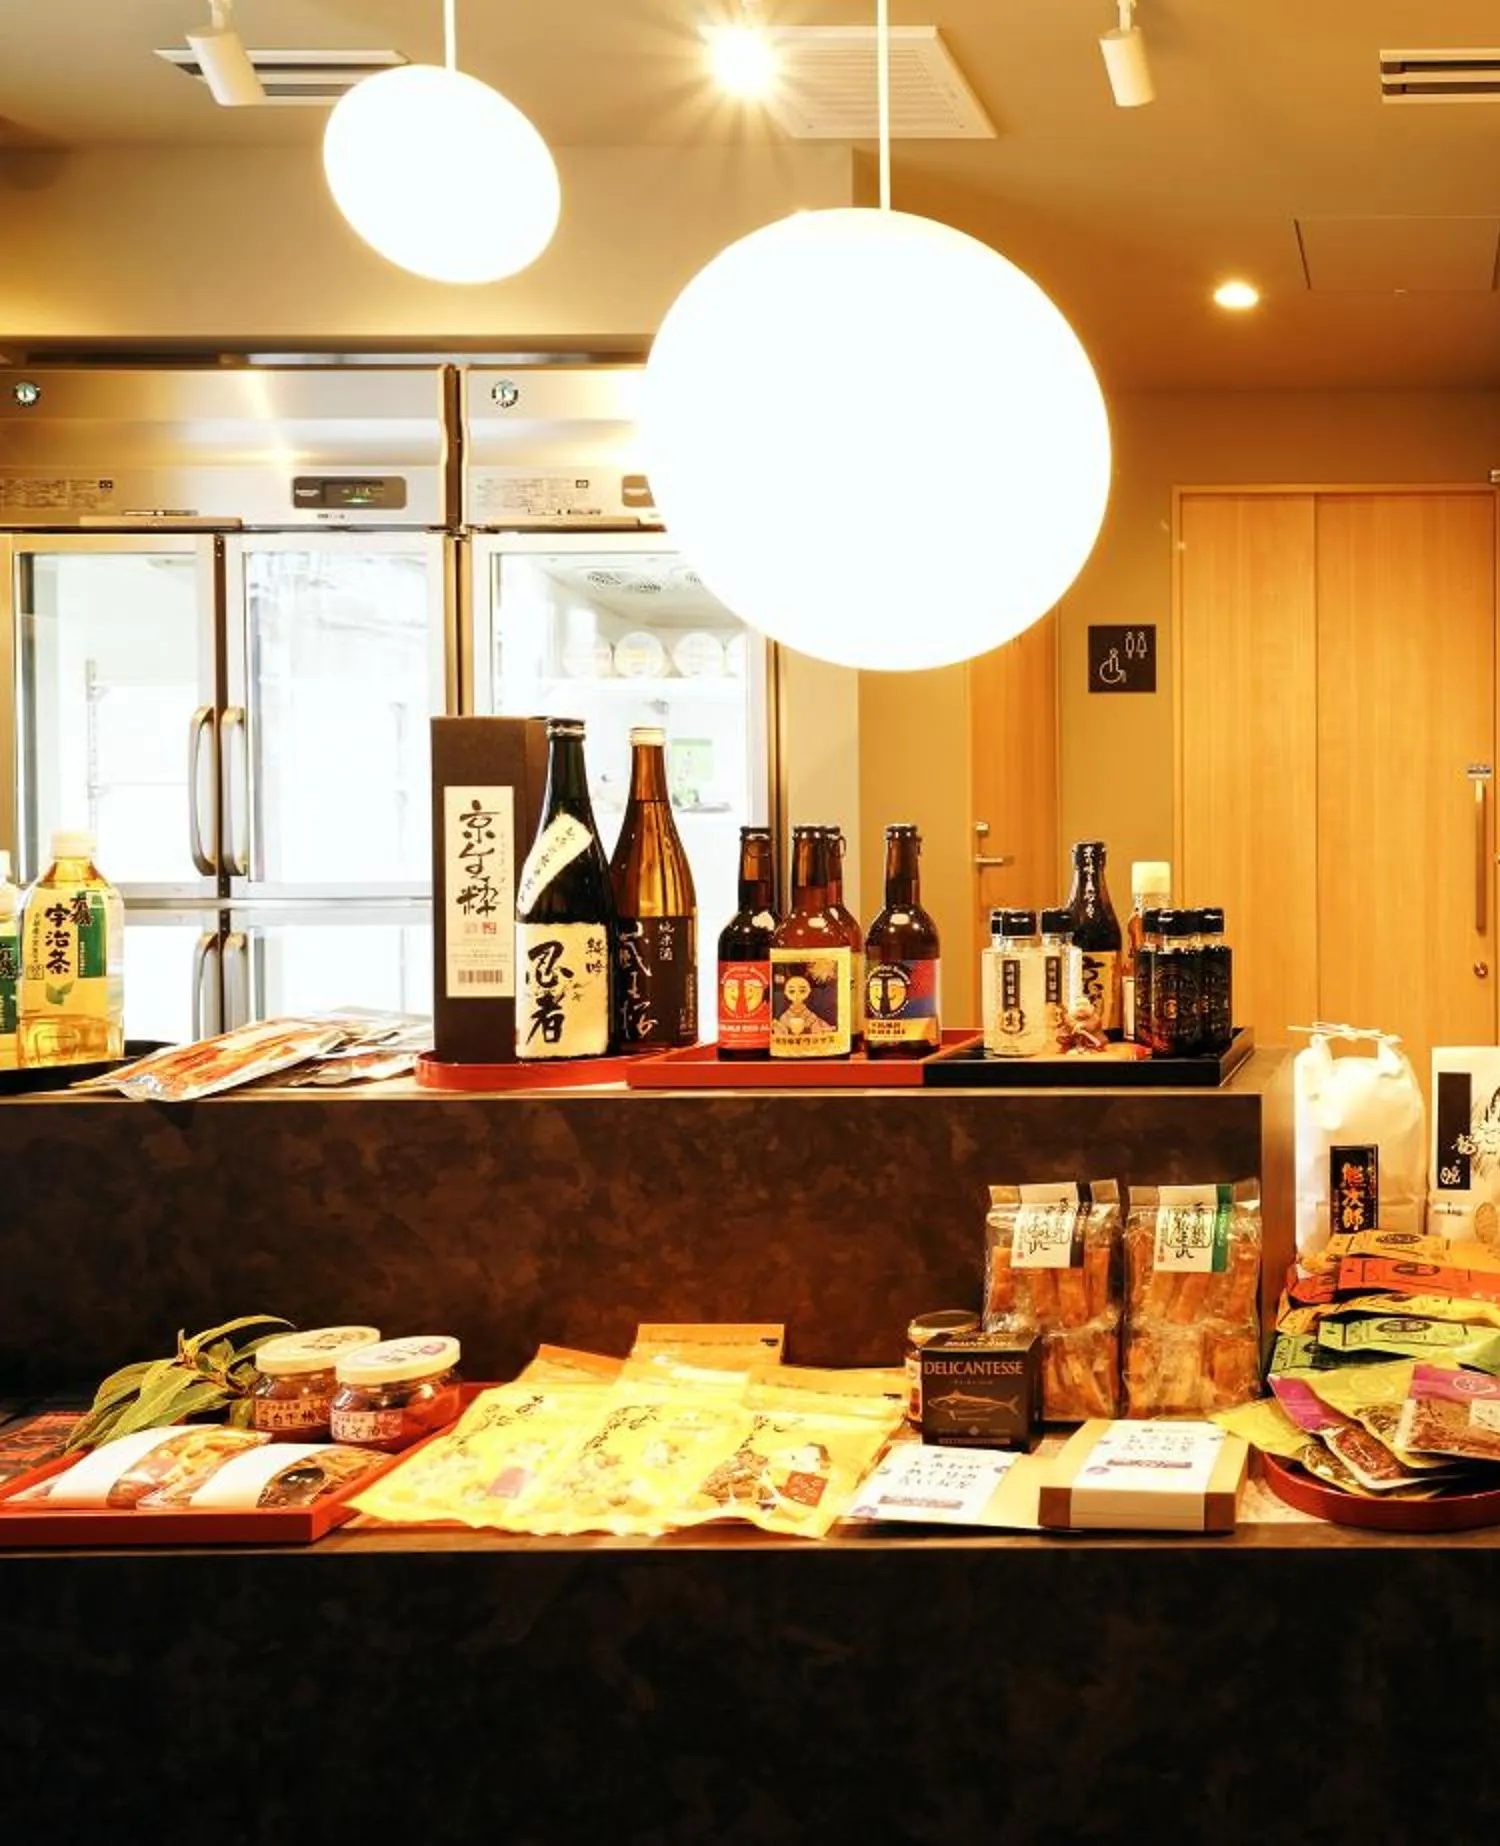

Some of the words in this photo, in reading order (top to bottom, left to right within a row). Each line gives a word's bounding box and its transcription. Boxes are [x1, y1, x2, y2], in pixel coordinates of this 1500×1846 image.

[44, 903, 71, 975] 宇治茶
[524, 939, 575, 1045] 忍者
[923, 1360, 1025, 1376] DELICANTESSE
